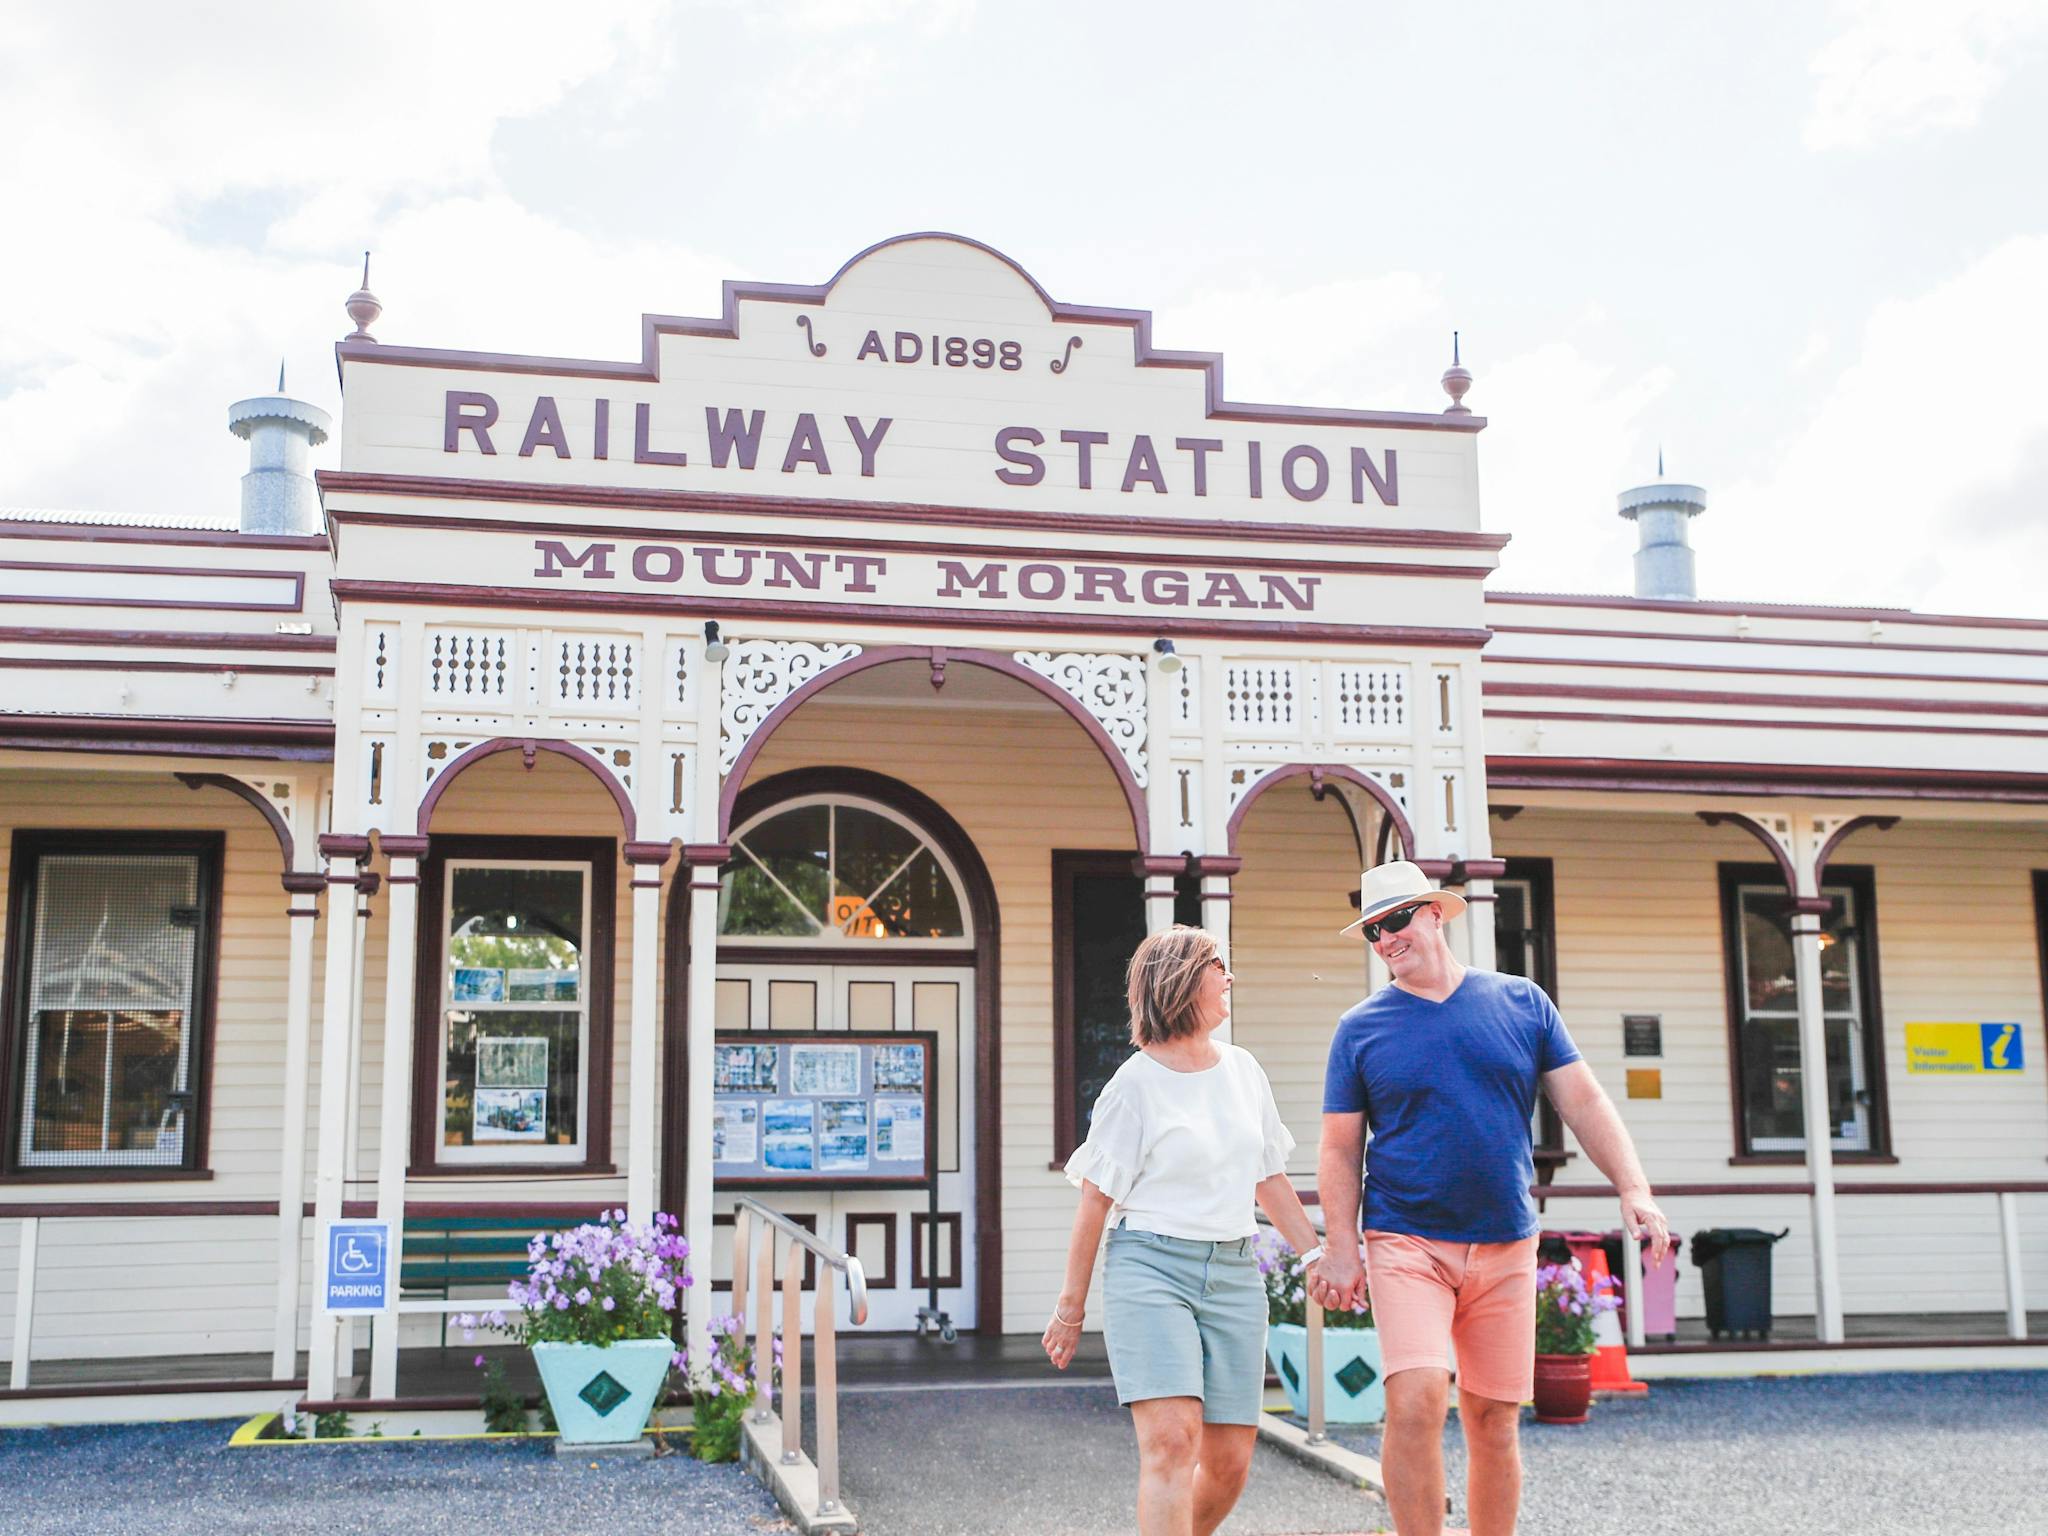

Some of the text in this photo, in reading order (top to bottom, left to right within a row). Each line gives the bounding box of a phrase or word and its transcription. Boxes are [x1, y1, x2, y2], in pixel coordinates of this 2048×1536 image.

[443, 390, 1399, 506] RAILWAY STATION
[534, 540, 1322, 611] MOUNT MORGAN
[1914, 1062, 1975, 1072] Information
[330, 1285, 382, 1297] PARKING
